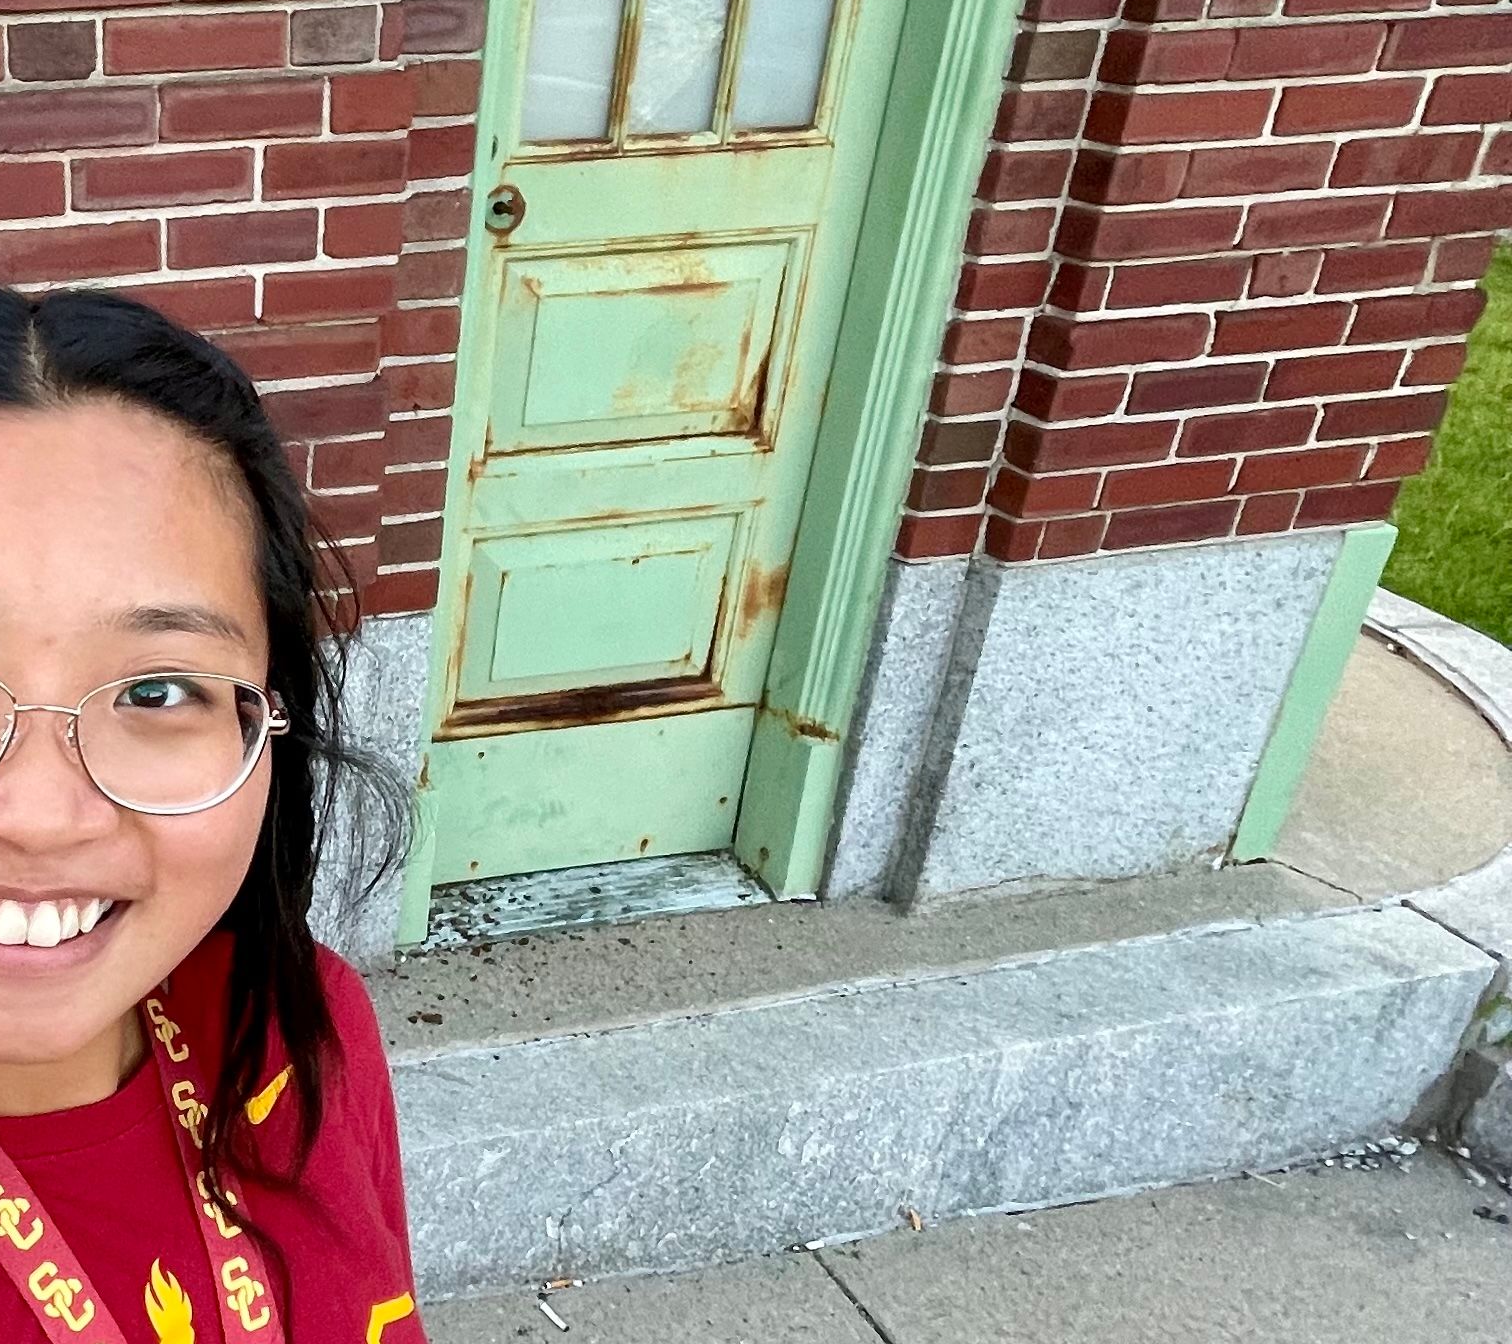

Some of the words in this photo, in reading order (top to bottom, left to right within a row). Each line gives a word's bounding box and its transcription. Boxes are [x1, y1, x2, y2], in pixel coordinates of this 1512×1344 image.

[147, 999, 188, 1062] SC
[221, 1256, 270, 1331] SC
[29, 1262, 94, 1331] SC
